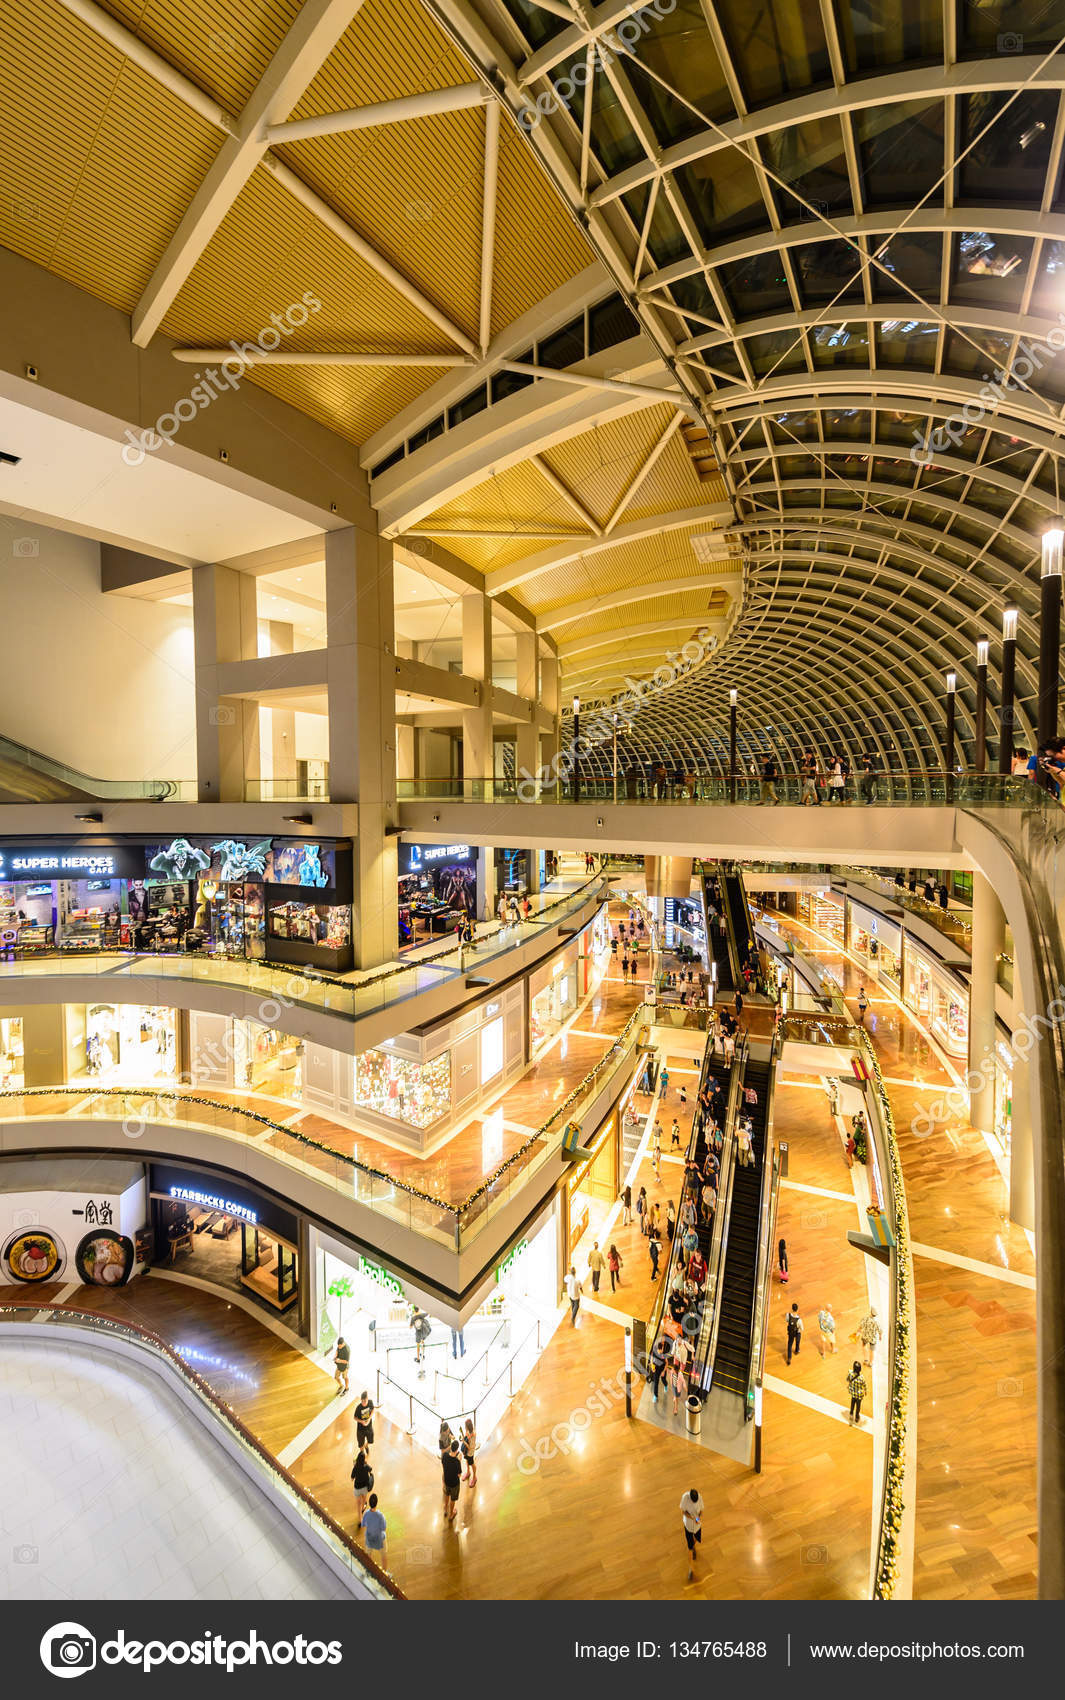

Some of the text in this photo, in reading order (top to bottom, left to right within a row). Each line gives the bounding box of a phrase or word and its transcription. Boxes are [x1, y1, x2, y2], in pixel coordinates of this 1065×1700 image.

[424, 844, 469, 860] SUPER HEROES
[12, 858, 58, 869] SUPER
[61, 857, 113, 868] HEROES
[88, 866, 114, 874] CAFE
[170, 1187, 257, 1222] STARBUCKS COFFEE
